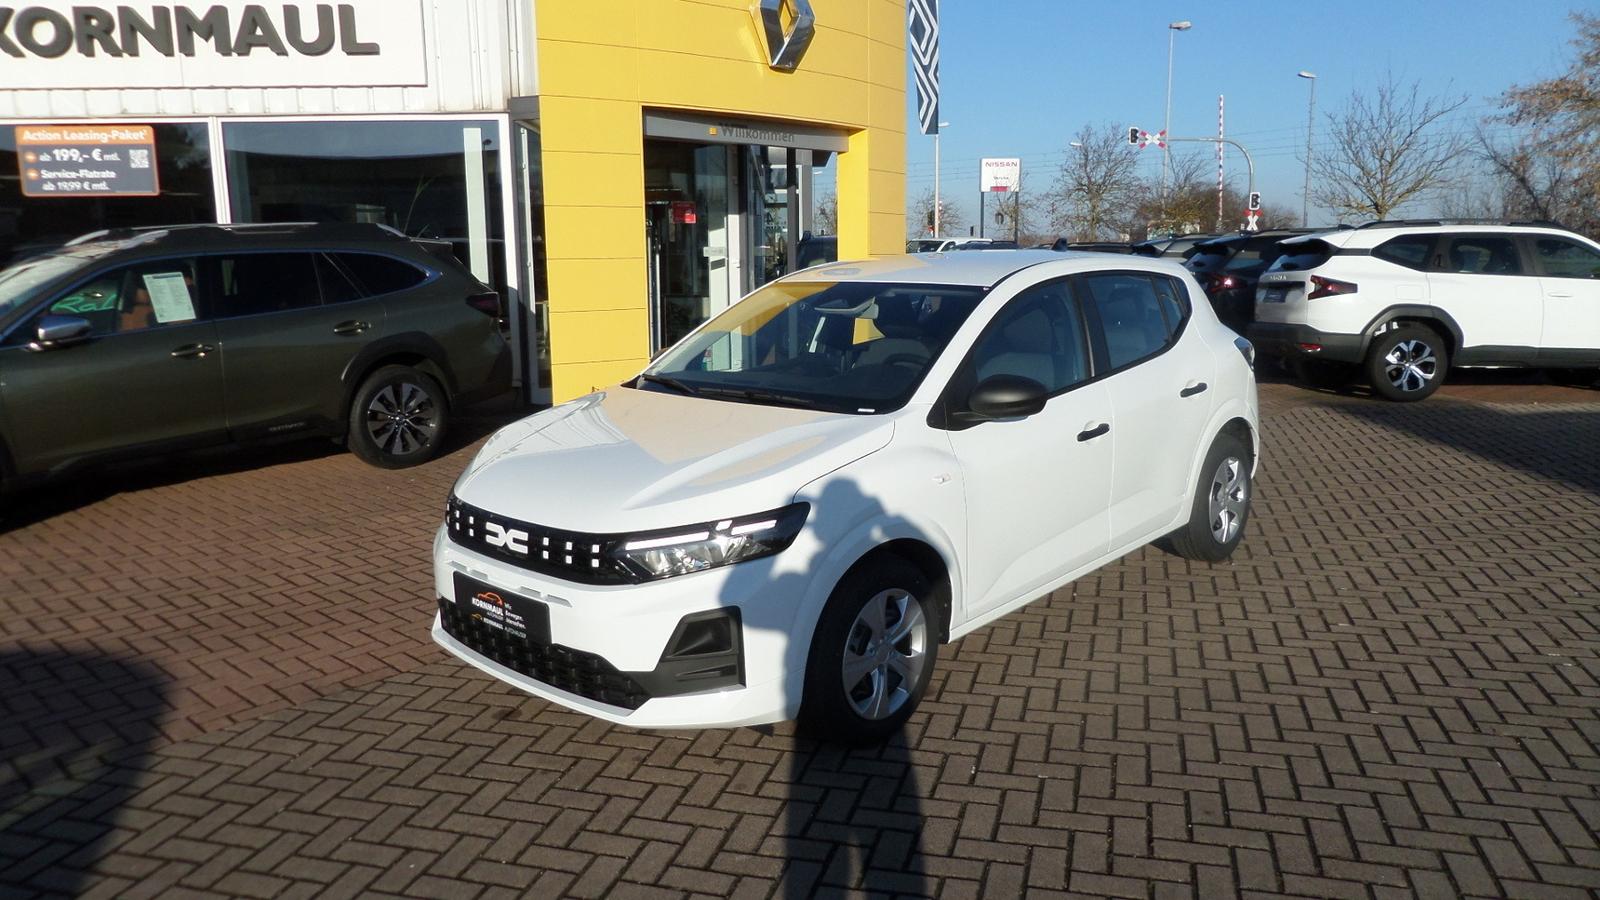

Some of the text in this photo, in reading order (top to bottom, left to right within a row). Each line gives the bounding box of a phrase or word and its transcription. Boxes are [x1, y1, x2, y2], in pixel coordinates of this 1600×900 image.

[23, 130, 61, 141] Action
[720, 124, 793, 142] Willkommen
[40, 152, 52, 161] ab
[91, 148, 103, 161] €
[41, 169, 116, 179] Service-Flatrate
[42, 181, 56, 191] ab
[83, 181, 91, 191] €
[471, 597, 504, 616] KORNMAUL
